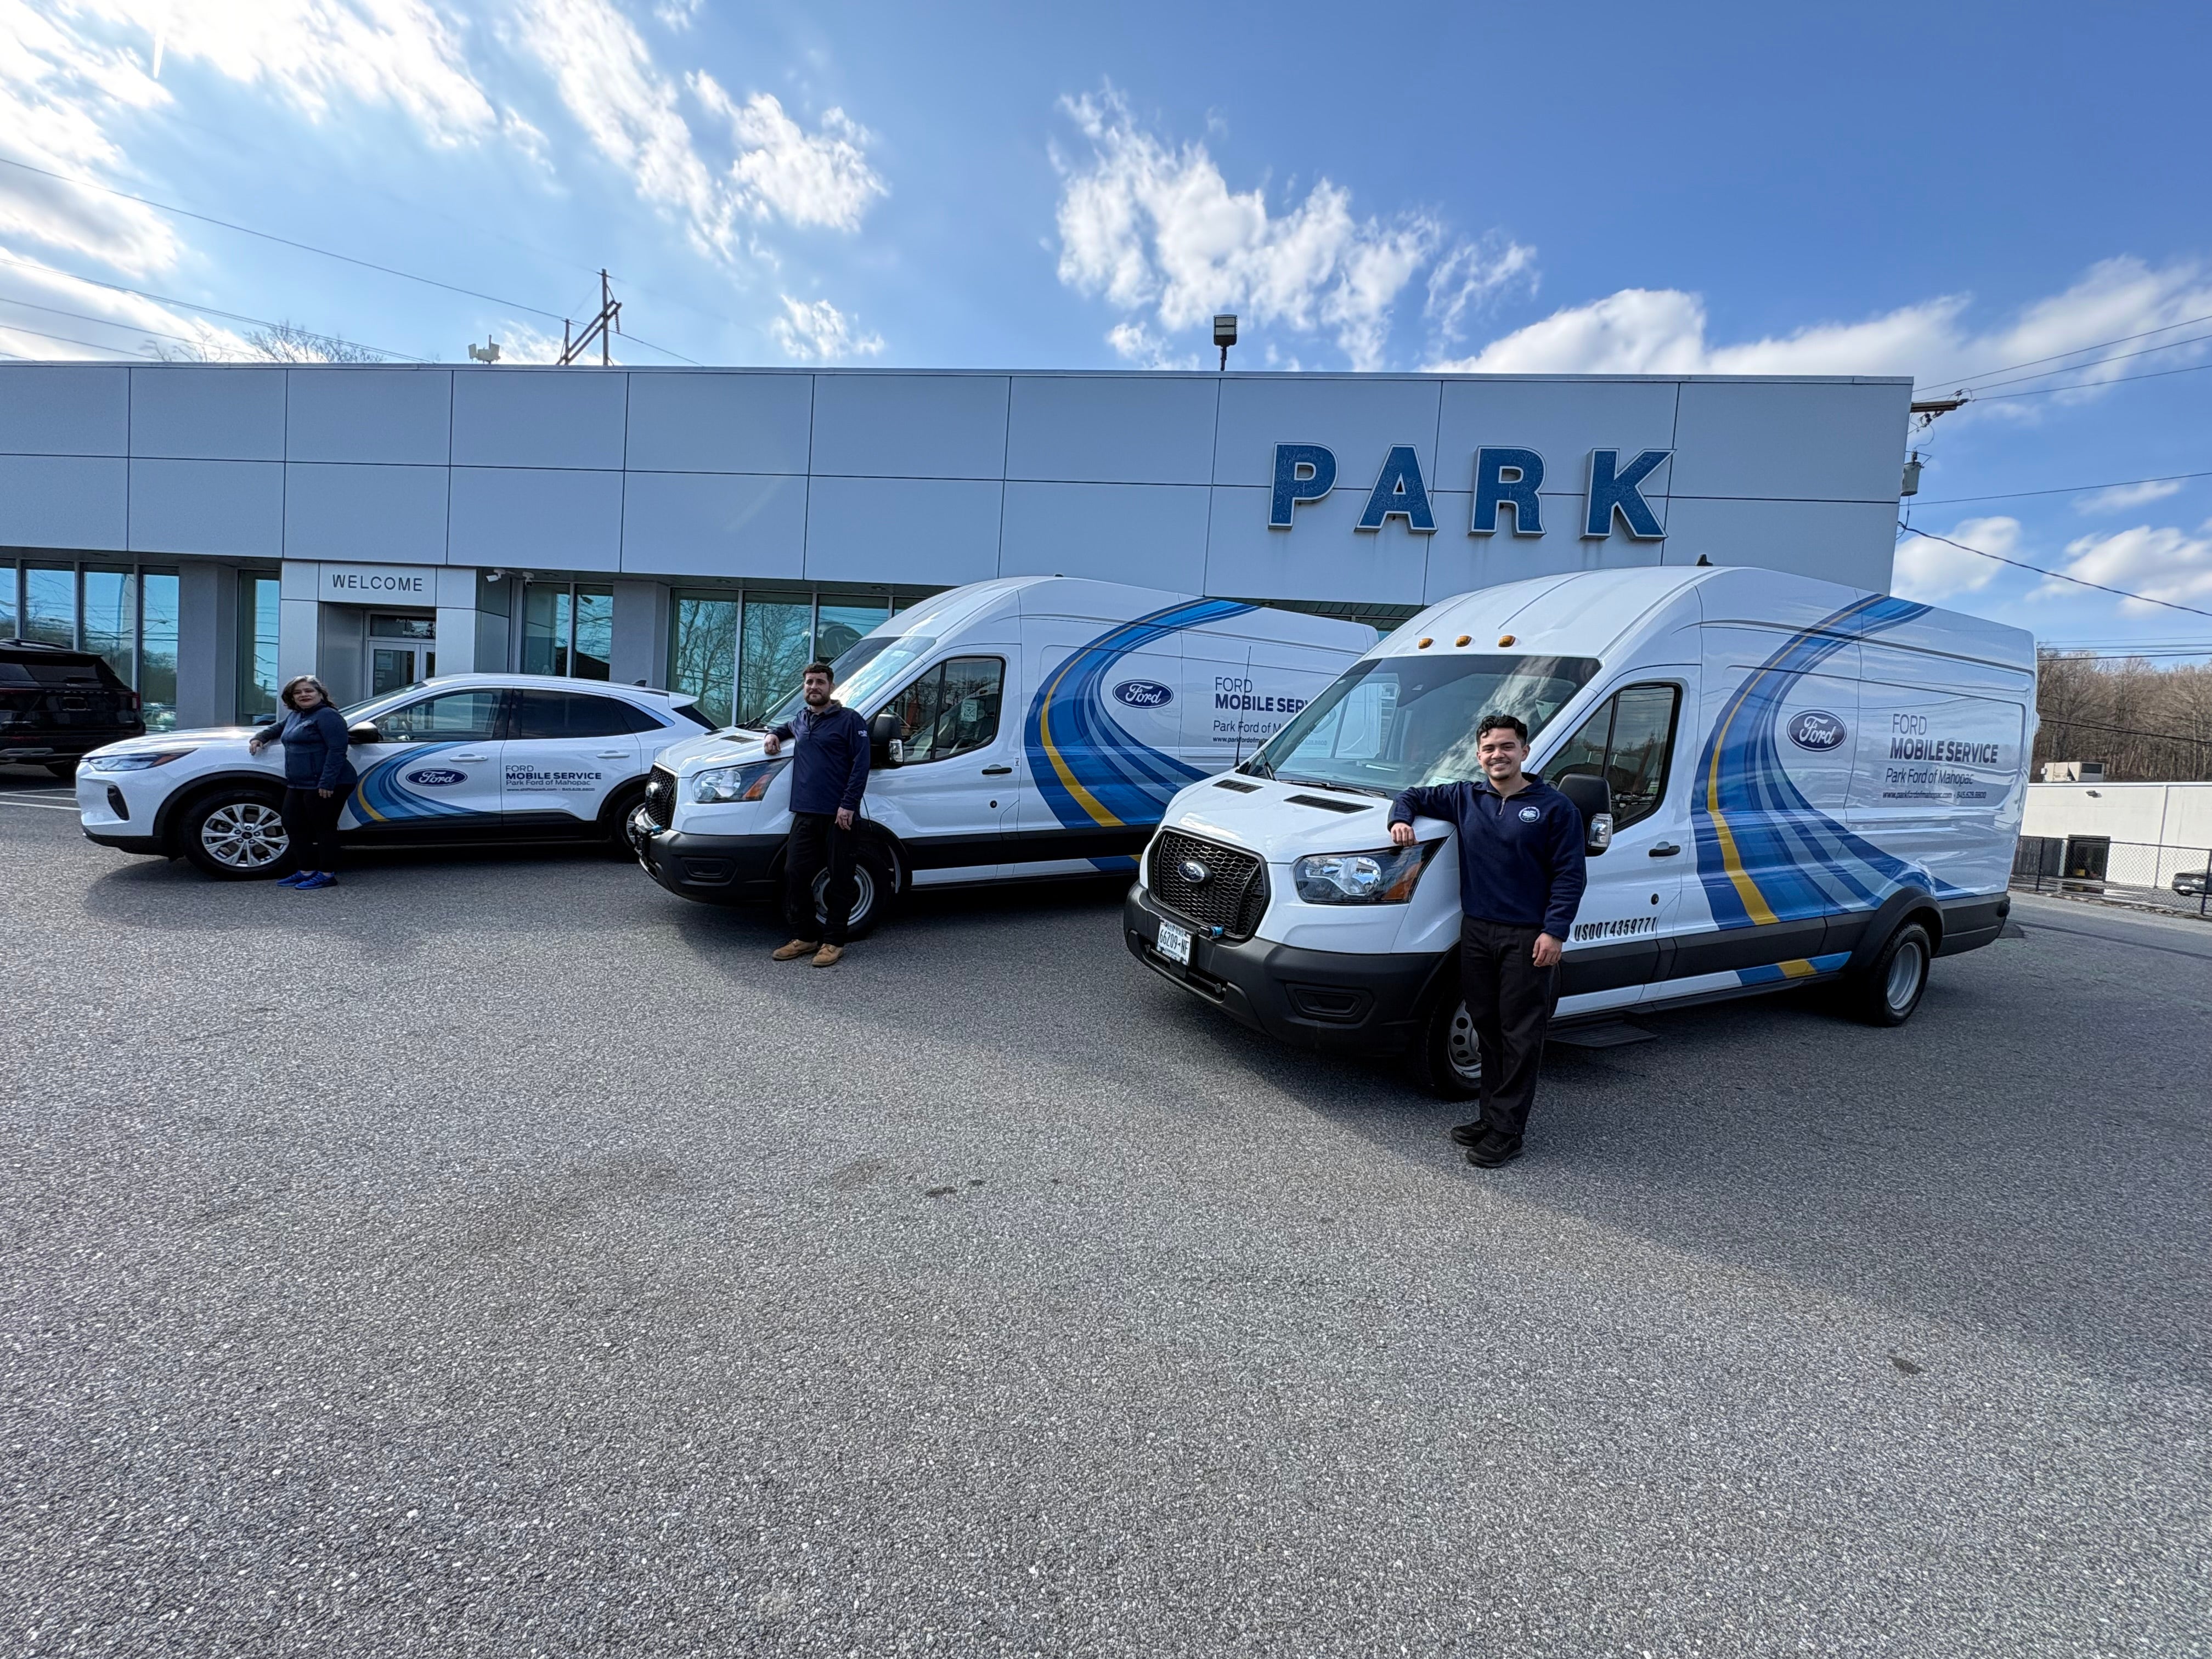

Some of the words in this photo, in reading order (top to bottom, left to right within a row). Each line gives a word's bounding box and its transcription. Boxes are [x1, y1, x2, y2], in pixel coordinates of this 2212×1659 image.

[1268, 442, 1677, 540] PARK
[332, 574, 422, 592] WELCOME
[1125, 684, 1162, 703] Ford
[1215, 676, 1253, 693] FORD
[1215, 693, 1274, 712] MOBILE
[1214, 720, 1235, 732] Park
[1238, 721, 1259, 733] Ford
[1261, 723, 1272, 734] of
[1799, 716, 1837, 744] Ford
[1893, 713, 1927, 735] FORD
[1890, 737, 1945, 760] MOBILE
[1945, 741, 1999, 763] SERVICE
[419, 771, 455, 783] Ford
[1886, 768, 1907, 783] Park
[1908, 769, 1928, 784] Ford
[1928, 769, 1938, 784] of
[1938, 770, 1974, 787] Mahopac
